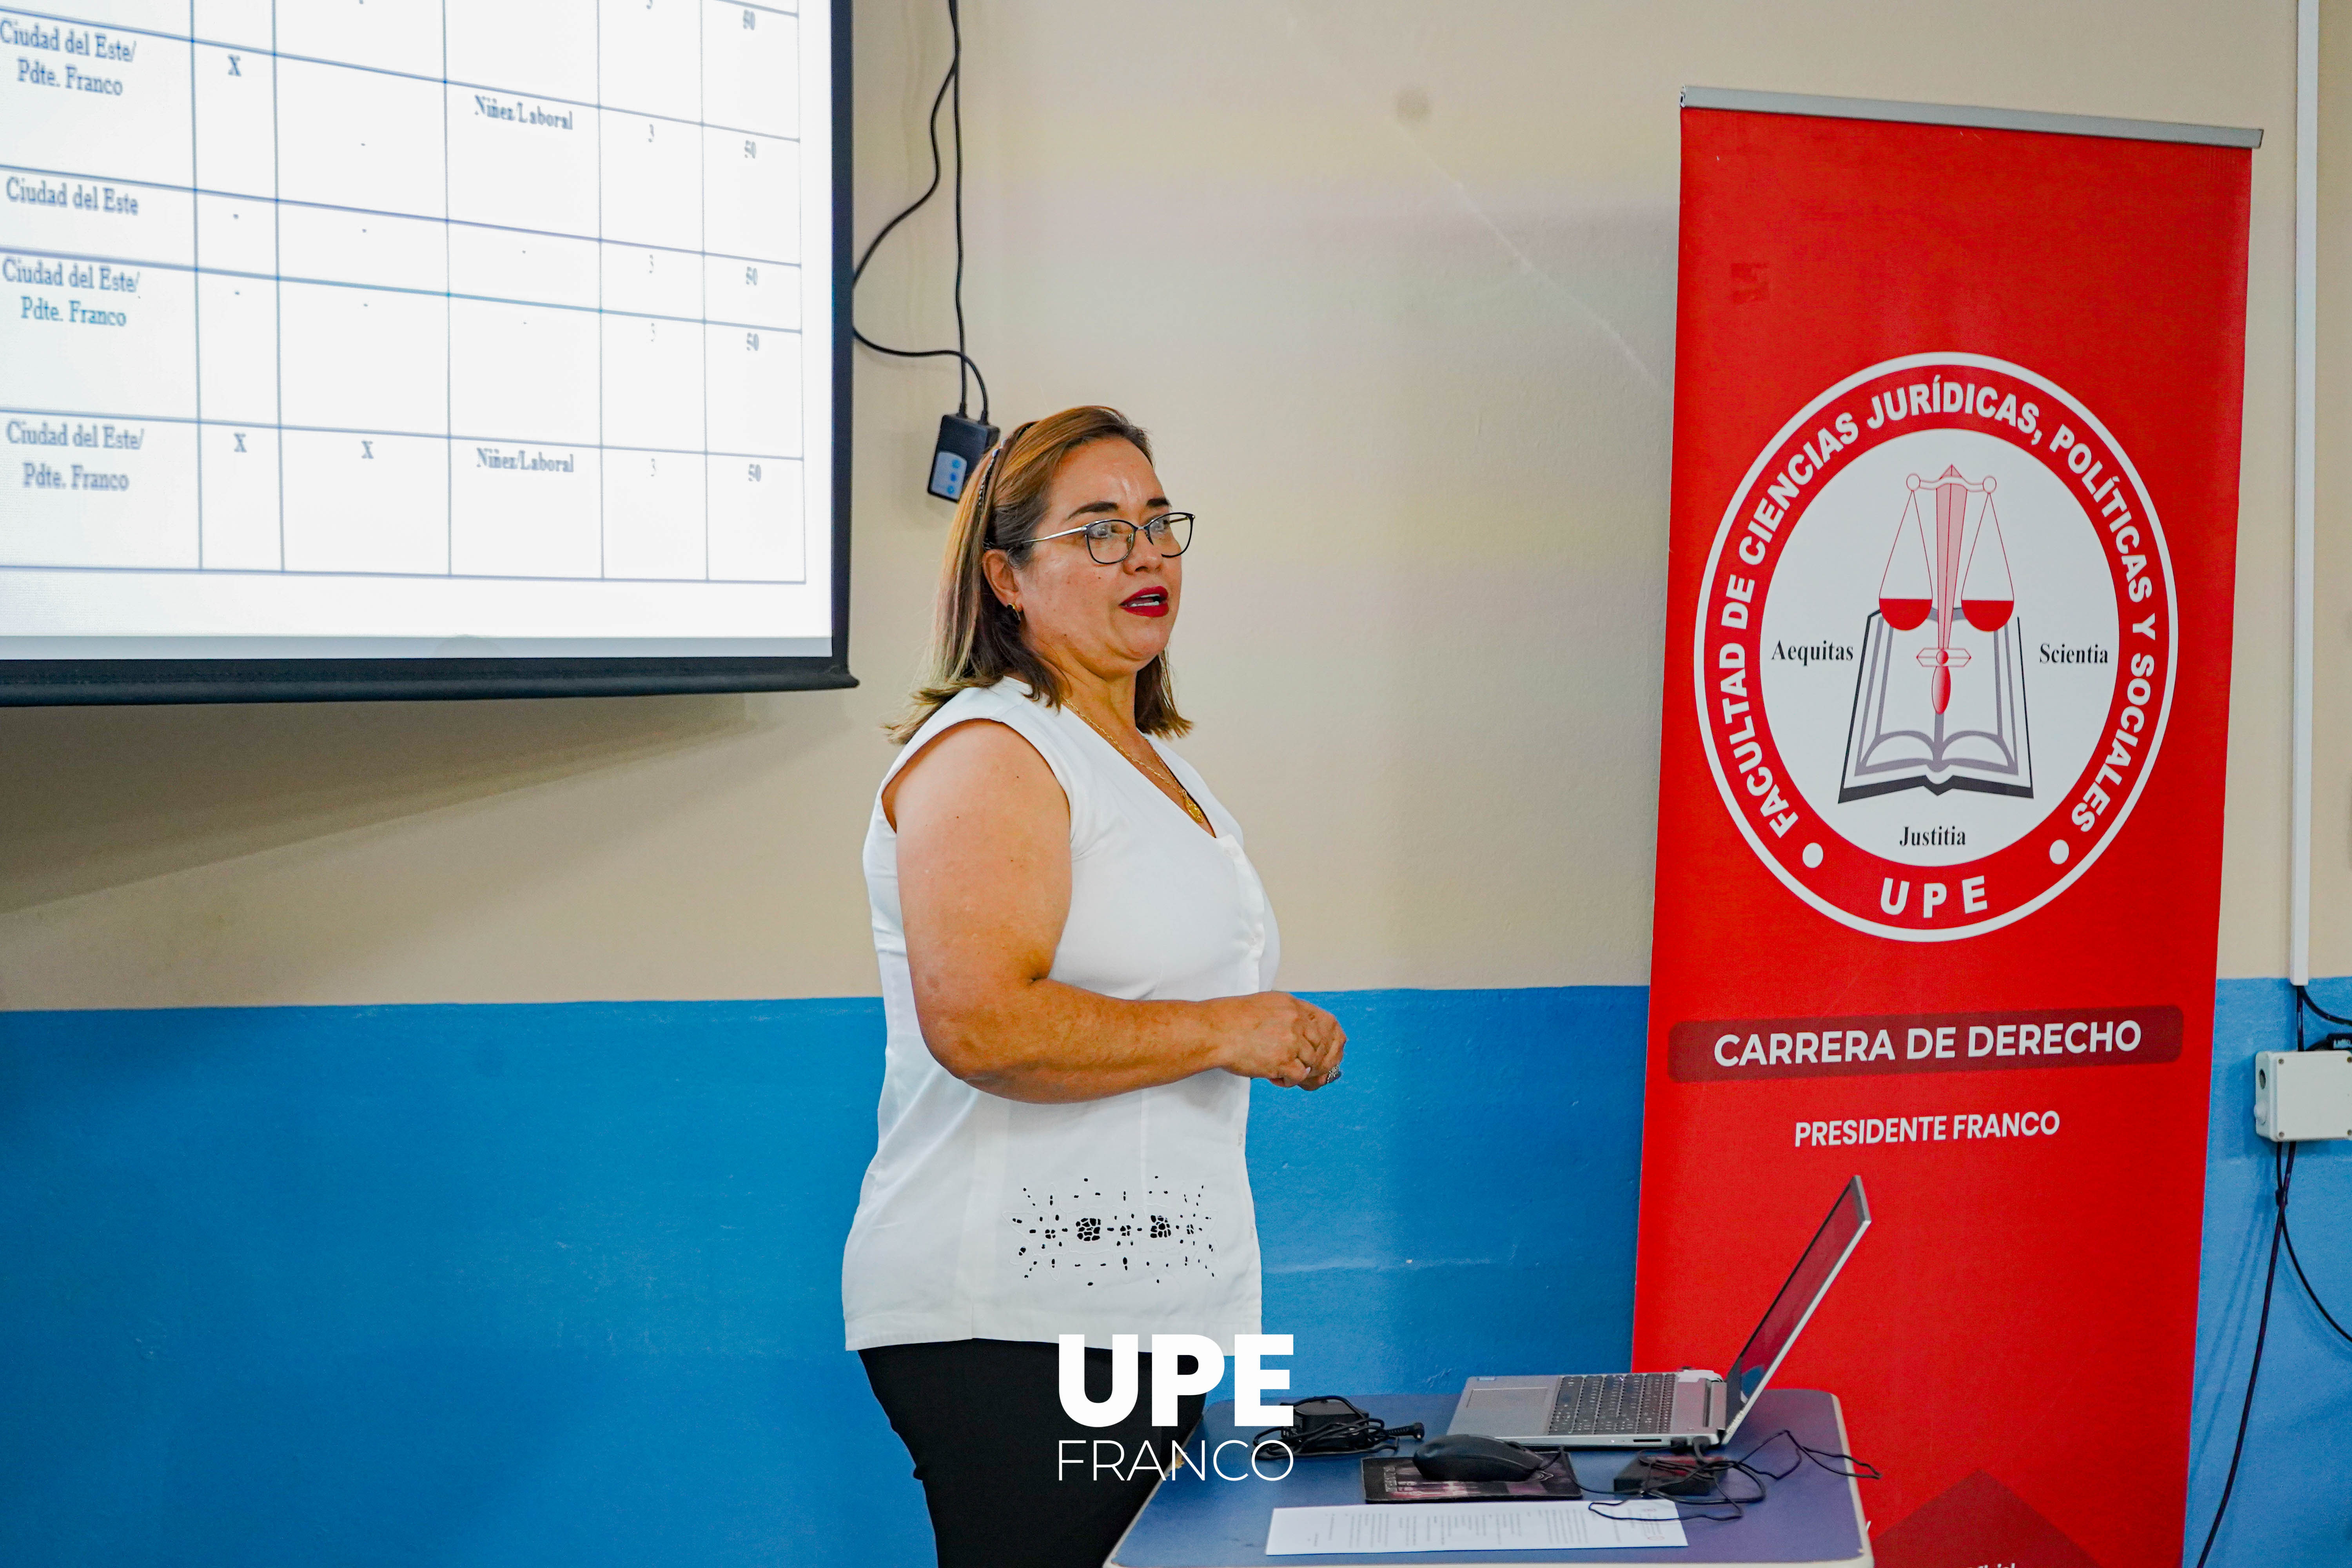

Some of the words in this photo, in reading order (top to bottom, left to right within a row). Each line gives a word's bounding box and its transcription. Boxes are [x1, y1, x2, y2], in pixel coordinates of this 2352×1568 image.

[0, 20, 61, 52] Ciudad
[65, 28, 91, 56] del
[95, 32, 137, 62] Este/
[17, 56, 60, 87] Pdte.
[65, 63, 123, 96] Franco
[6, 176, 68, 208] Ciudad
[73, 184, 98, 211] del
[103, 187, 139, 215] Este
[2, 256, 64, 287] Ciudad
[69, 262, 94, 289] del
[99, 266, 140, 293] Este/
[20, 296, 64, 321] Pdte.
[69, 300, 127, 327] Franco
[1867, 374, 2043, 445] JURÍDICAS,
[6, 420, 69, 447] Ciudad
[73, 423, 99, 448] del
[102, 424, 145, 450] Este/
[23, 462, 67, 489] Pdte.
[71, 464, 130, 491] Franco
[1739, 412, 1859, 565] CIENCIAS
[2049, 423, 2152, 603] POLÍTICAS
[1720, 573, 1755, 630] DE
[2132, 613, 2156, 641] Y
[1771, 639, 1854, 666] Aequitas
[2039, 643, 2109, 664] Scientia
[1719, 642, 1799, 838] FACULTAD
[2071, 653, 2155, 832] SOCIALES
[1899, 825, 1966, 848] Justitia
[1714, 1029, 1896, 1067] CARRERA
[1906, 1026, 1956, 1060] DE
[1967, 1020, 2141, 1058] DERECHO
[1795, 1115, 1947, 1147] PRESIDENTE
[1953, 1110, 2060, 1140] FRANCO
